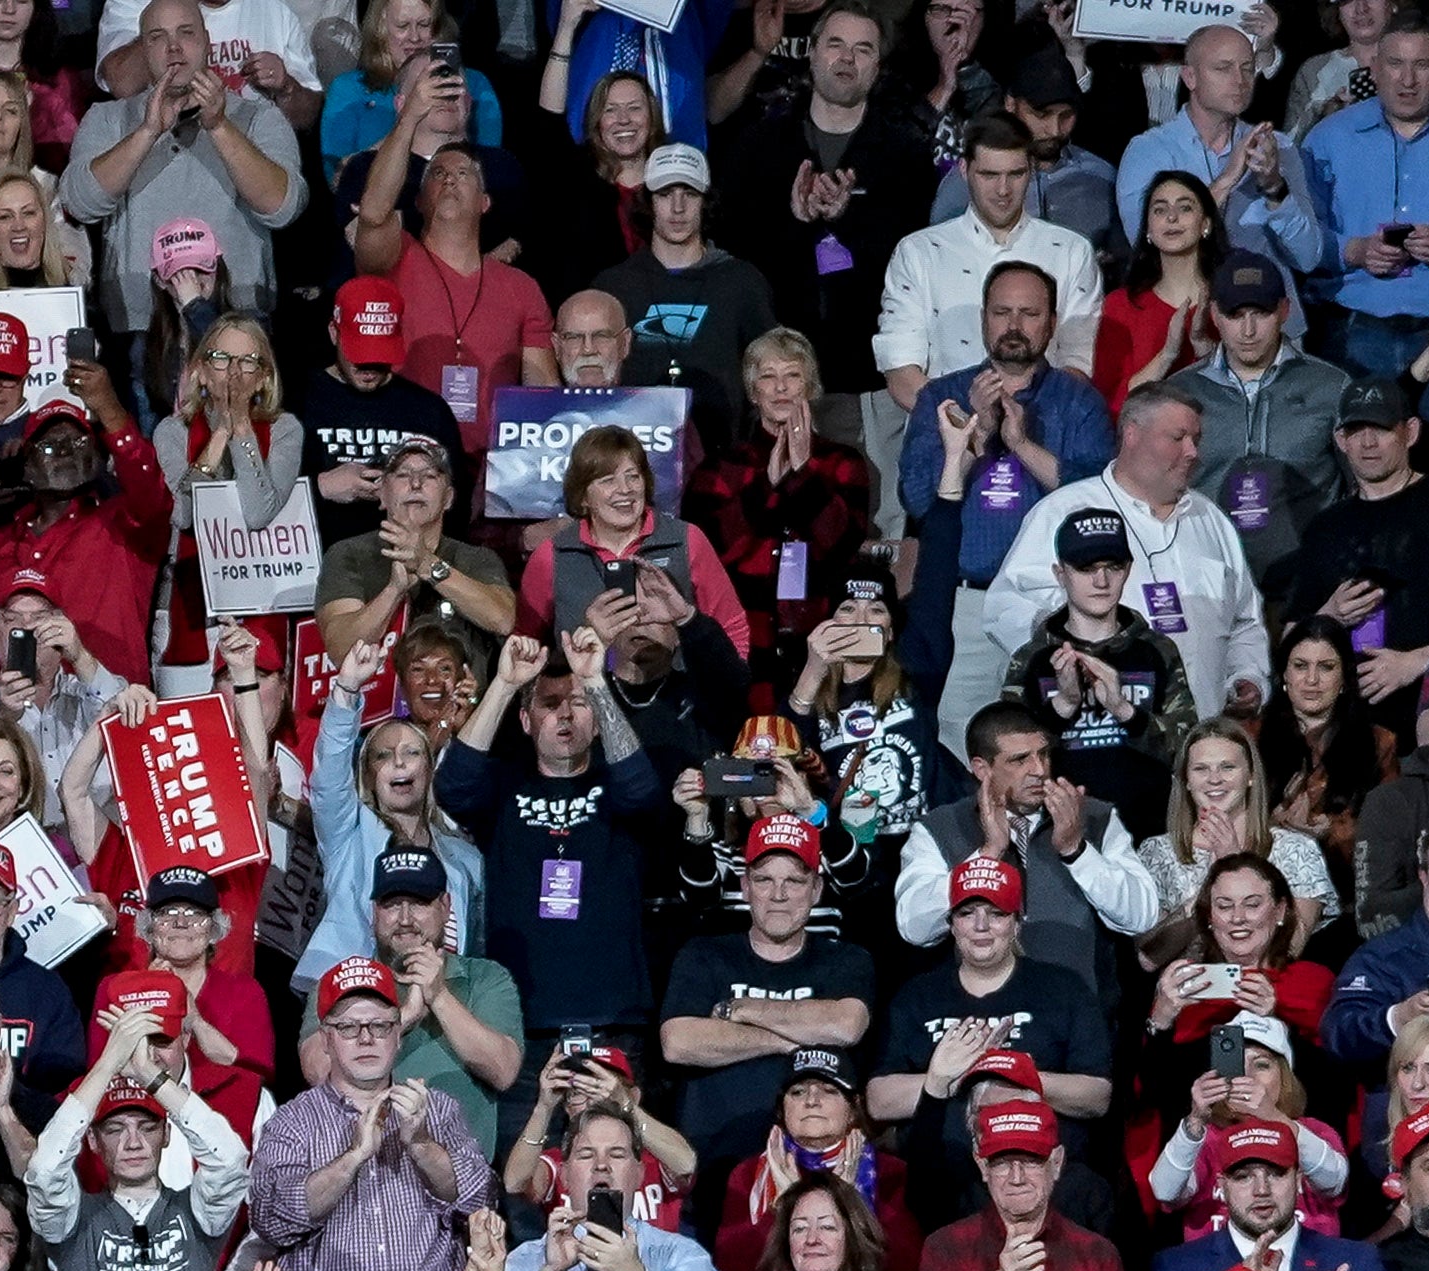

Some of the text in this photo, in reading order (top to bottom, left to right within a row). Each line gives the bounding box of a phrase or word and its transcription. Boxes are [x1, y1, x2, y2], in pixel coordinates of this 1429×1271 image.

[1163, 1, 1235, 22] TRUMP
[157, 230, 206, 250] TRUMP
[365, 302, 390, 313] KEEP
[353, 313, 398, 324] AMERICA
[1073, 516, 1121, 532] TRUMP
[202, 518, 311, 561] Women
[221, 560, 306, 582] FOR TRUMP
[148, 724, 197, 857] PENCE
[166, 707, 227, 861] TRUMP
[514, 786, 604, 814] TRUMP
[793, 1050, 839, 1068] Trump
